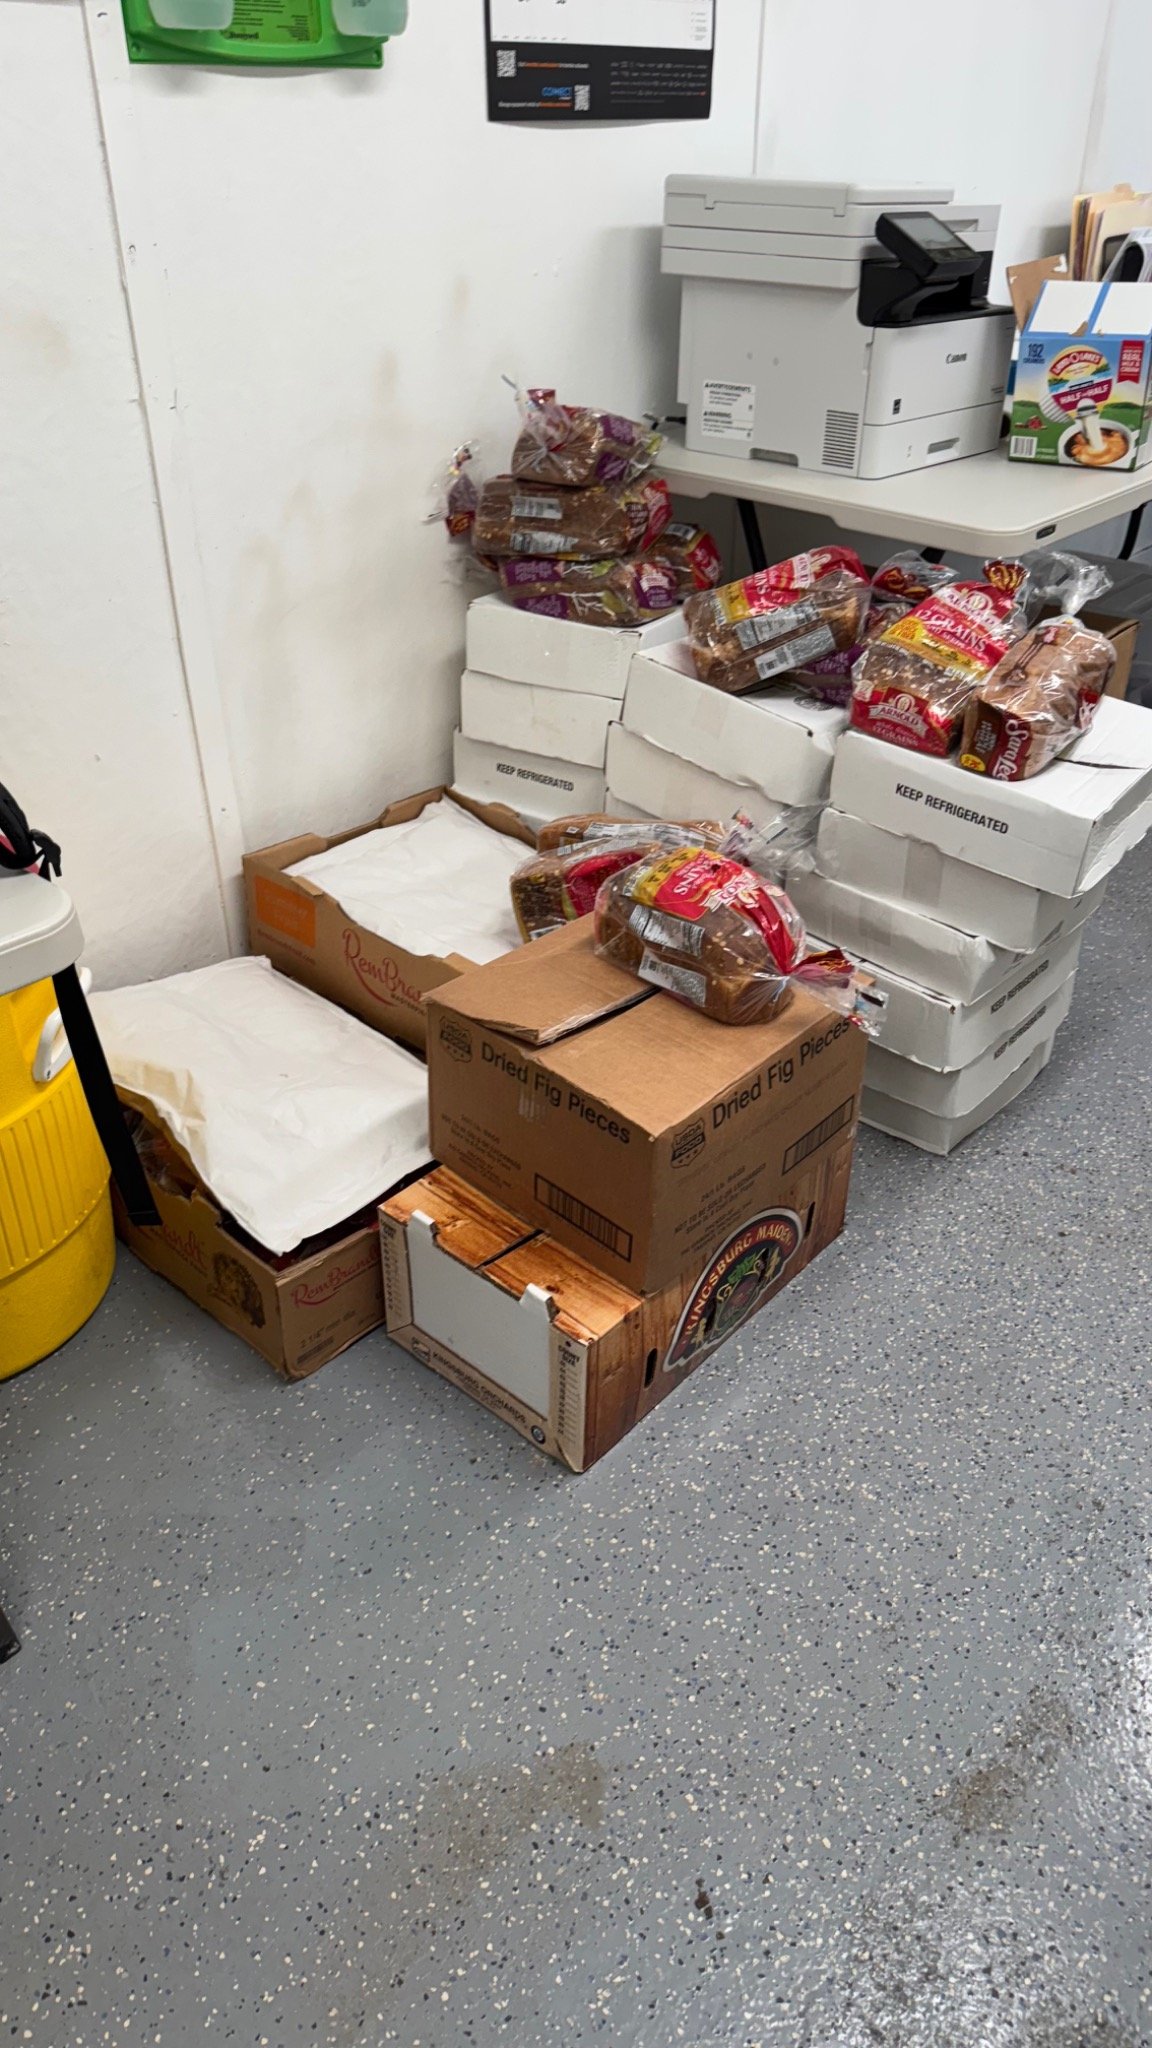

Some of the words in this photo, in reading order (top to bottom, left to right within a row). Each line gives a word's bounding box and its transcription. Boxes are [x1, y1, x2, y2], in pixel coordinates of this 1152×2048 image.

[945, 353, 967, 364] Canon
[880, 706, 920, 726] ARNOLD
[496, 763, 516, 776] KEEP
[517, 768, 574, 792] REFRIGERATED
[895, 782, 923, 802] KEEP
[924, 794, 1009, 835] REFRIGERATED
[481, 1041, 528, 1085] Dried
[534, 1072, 563, 1107] Fig
[568, 1091, 631, 1145] Pieces
[712, 1073, 762, 1130] Dried
[767, 1057, 794, 1090] Fig
[800, 1017, 850, 1067] Pieces
[685, 1233, 752, 1336] KINGSBURG
[756, 1223, 793, 1247] MAIDEN
